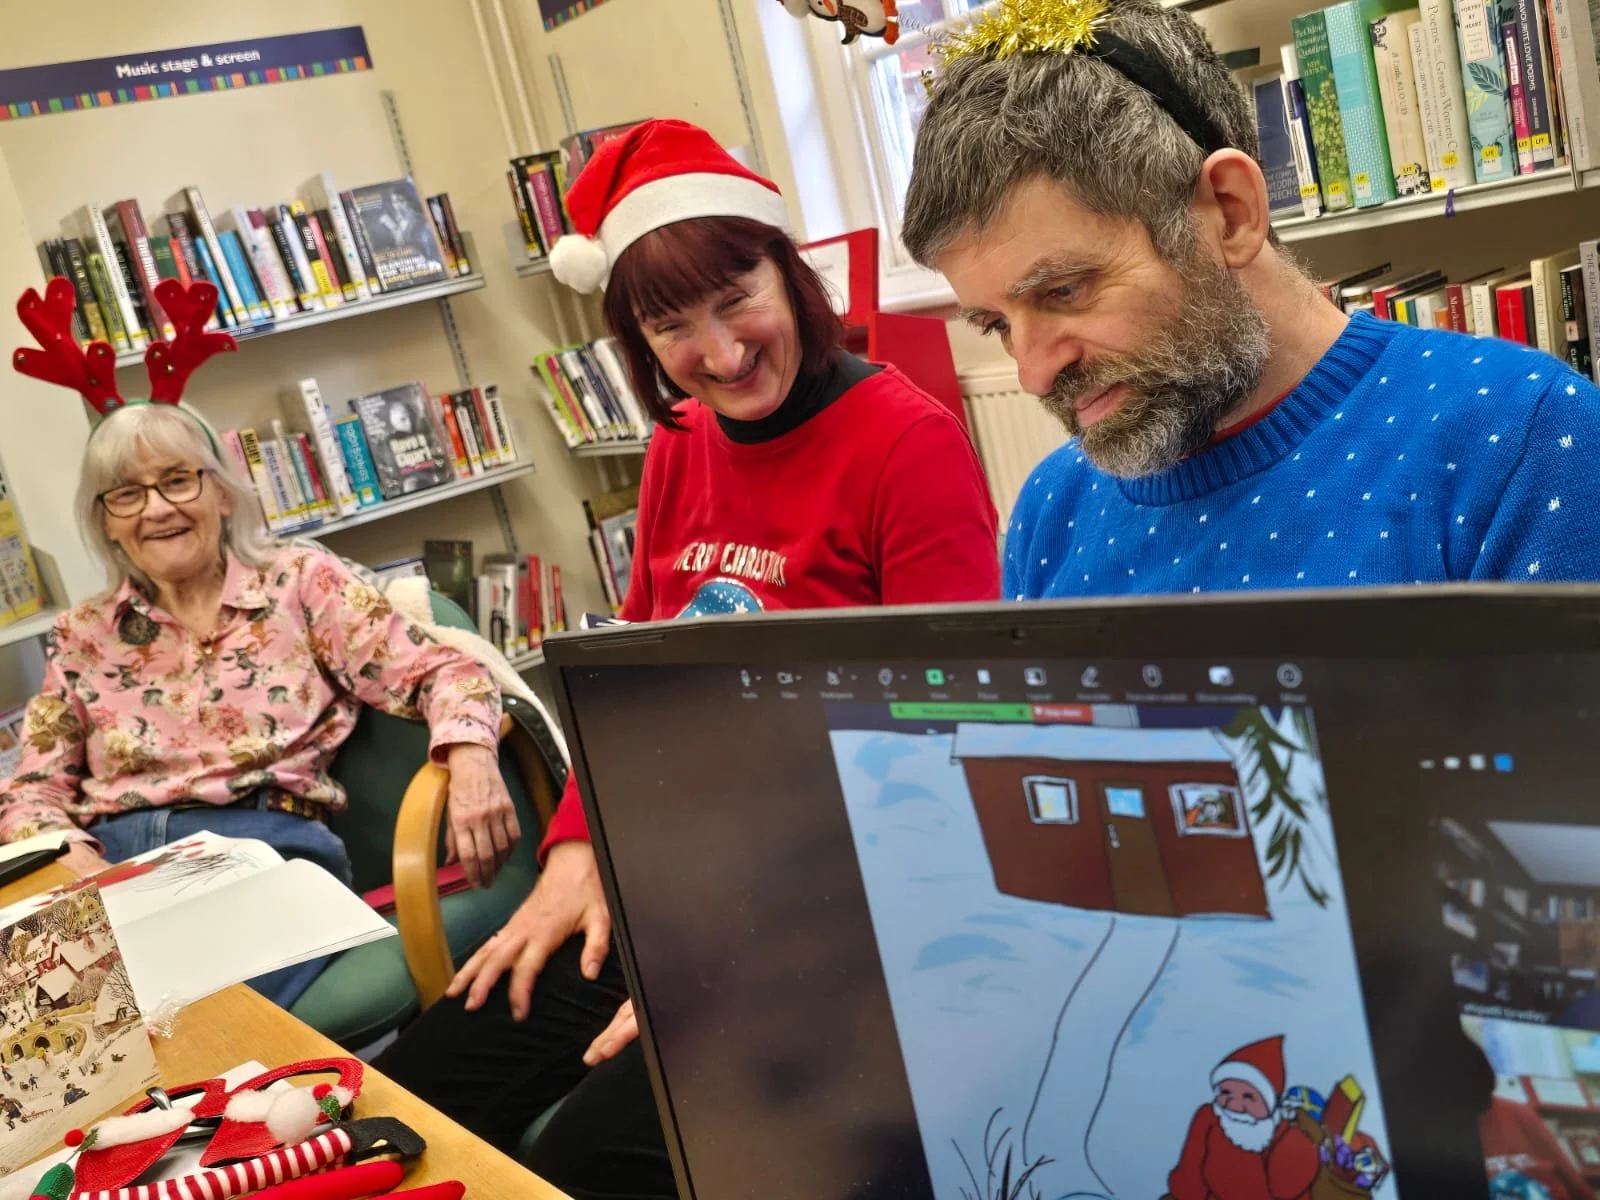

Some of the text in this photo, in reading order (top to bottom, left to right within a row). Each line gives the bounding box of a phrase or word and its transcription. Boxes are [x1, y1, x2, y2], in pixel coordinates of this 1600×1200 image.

[115, 50, 261, 79] Music stage & screen
[1526, 63, 1535, 91] POEMS
